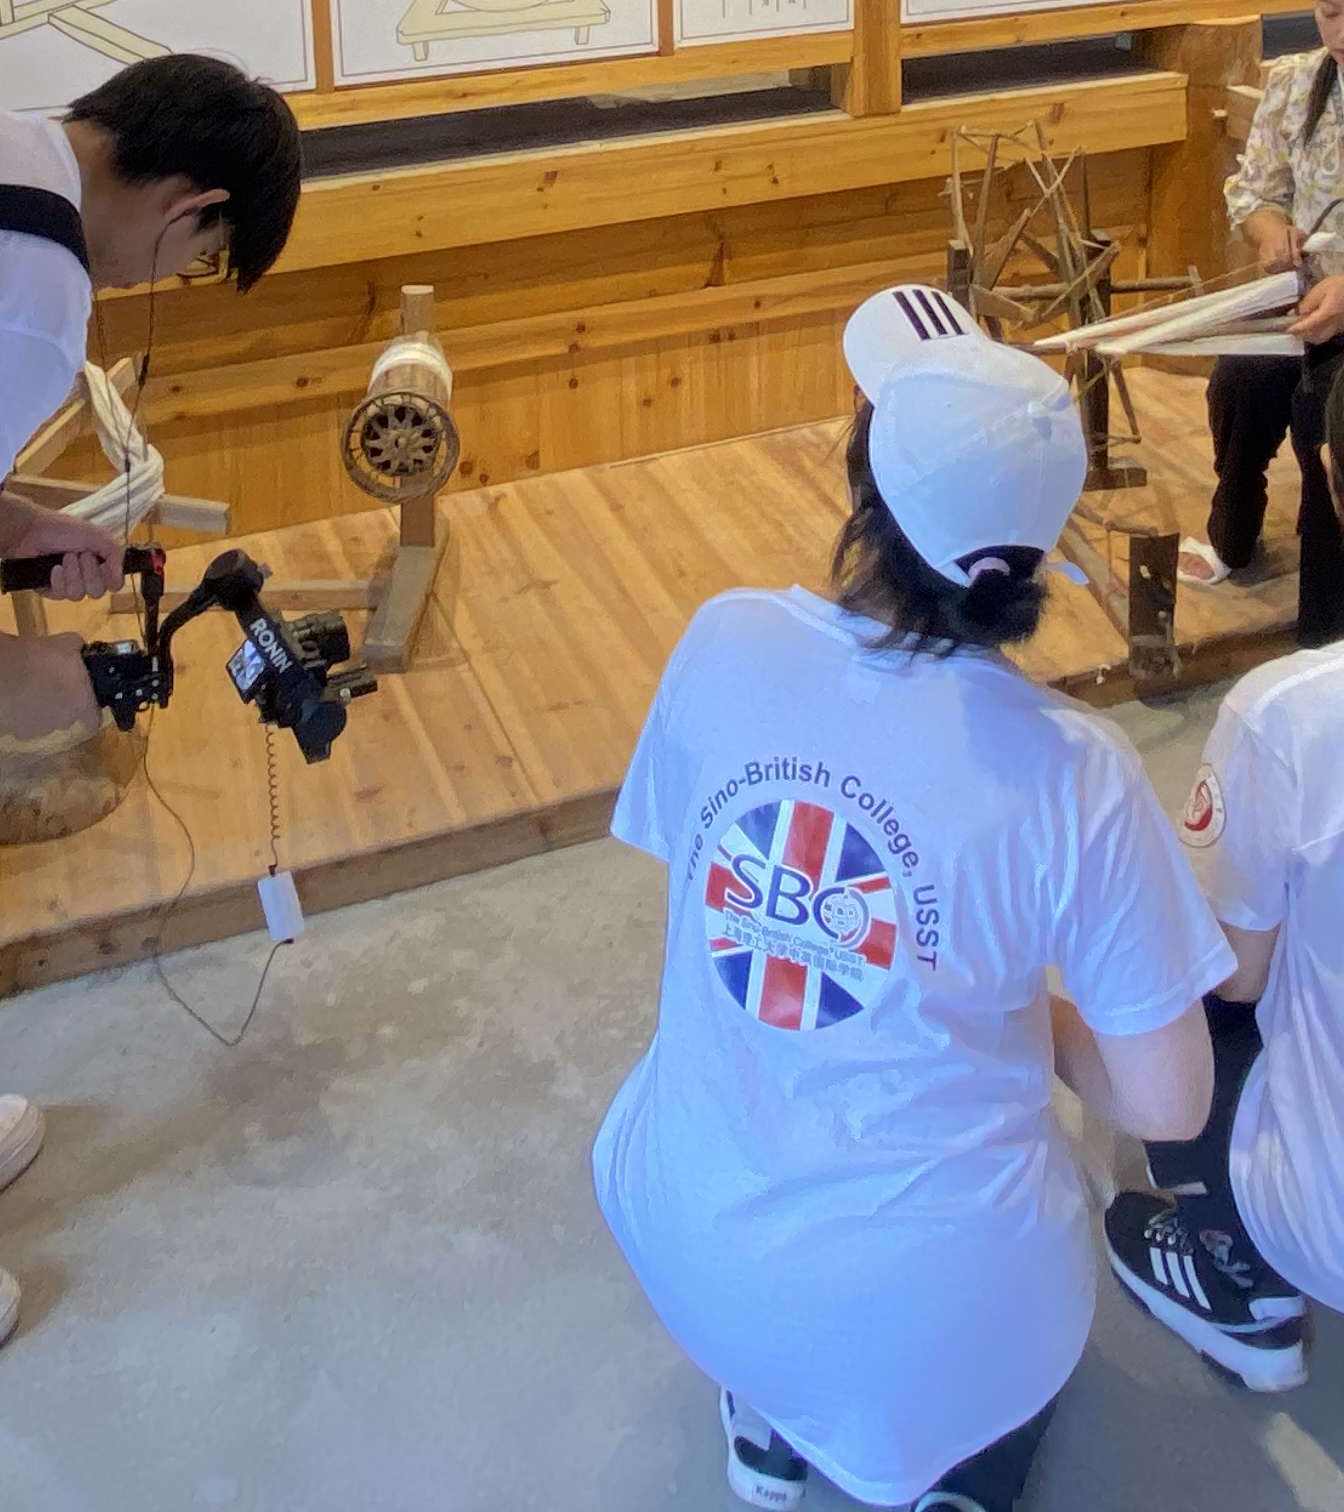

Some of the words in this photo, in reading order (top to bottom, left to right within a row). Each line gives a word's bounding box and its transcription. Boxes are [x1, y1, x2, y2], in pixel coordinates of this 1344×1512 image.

[250, 617, 292, 674] RONIN
[700, 756, 831, 830] Sino-British
[840, 774, 922, 879] College,
[912, 884, 940, 971] USST
[724, 851, 869, 948] SBC
